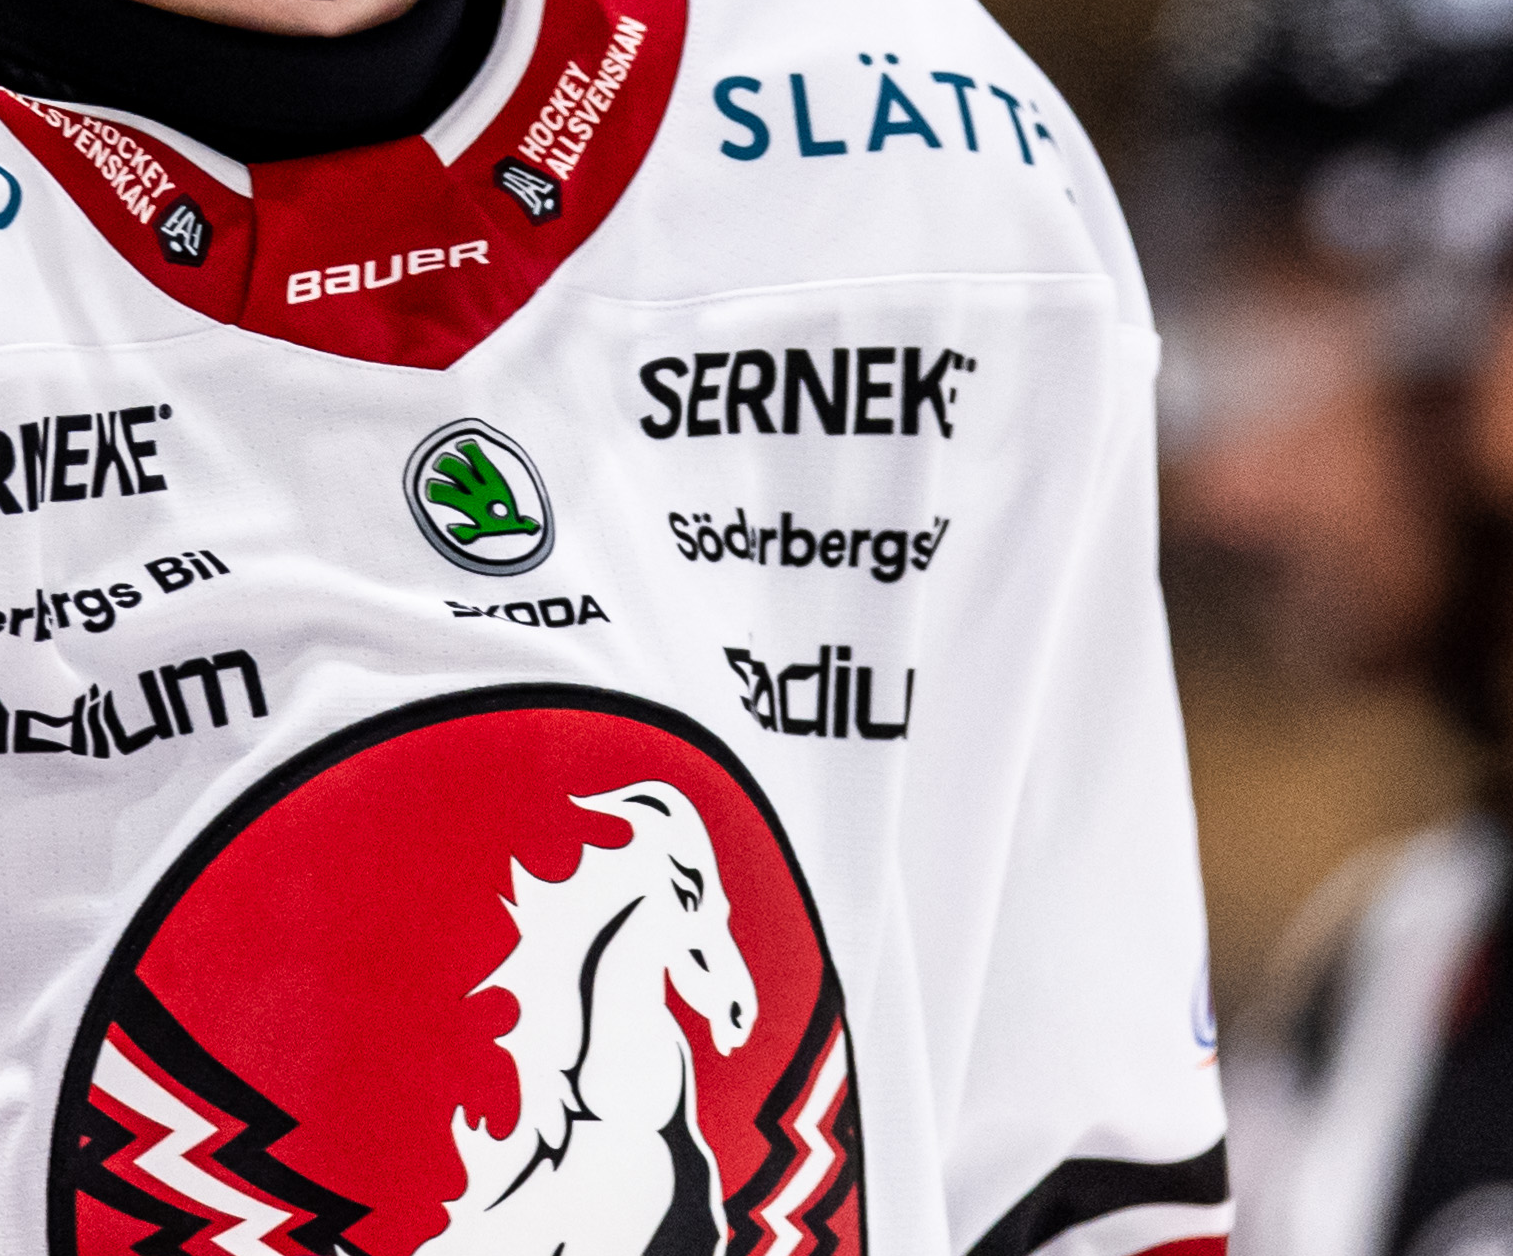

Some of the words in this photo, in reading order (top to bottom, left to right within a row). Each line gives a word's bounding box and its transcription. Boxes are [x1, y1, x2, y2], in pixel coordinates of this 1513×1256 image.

[517, 59, 590, 163] HOCKEY
[544, 14, 648, 182] ALLSVENSKAN
[712, 52, 1061, 164] SLÄTT
[82, 116, 176, 199] HOCKEY
[287, 239, 491, 304] BAUER
[144, 549, 230, 594] Bil
[668, 507, 937, 583] Södrbergs
